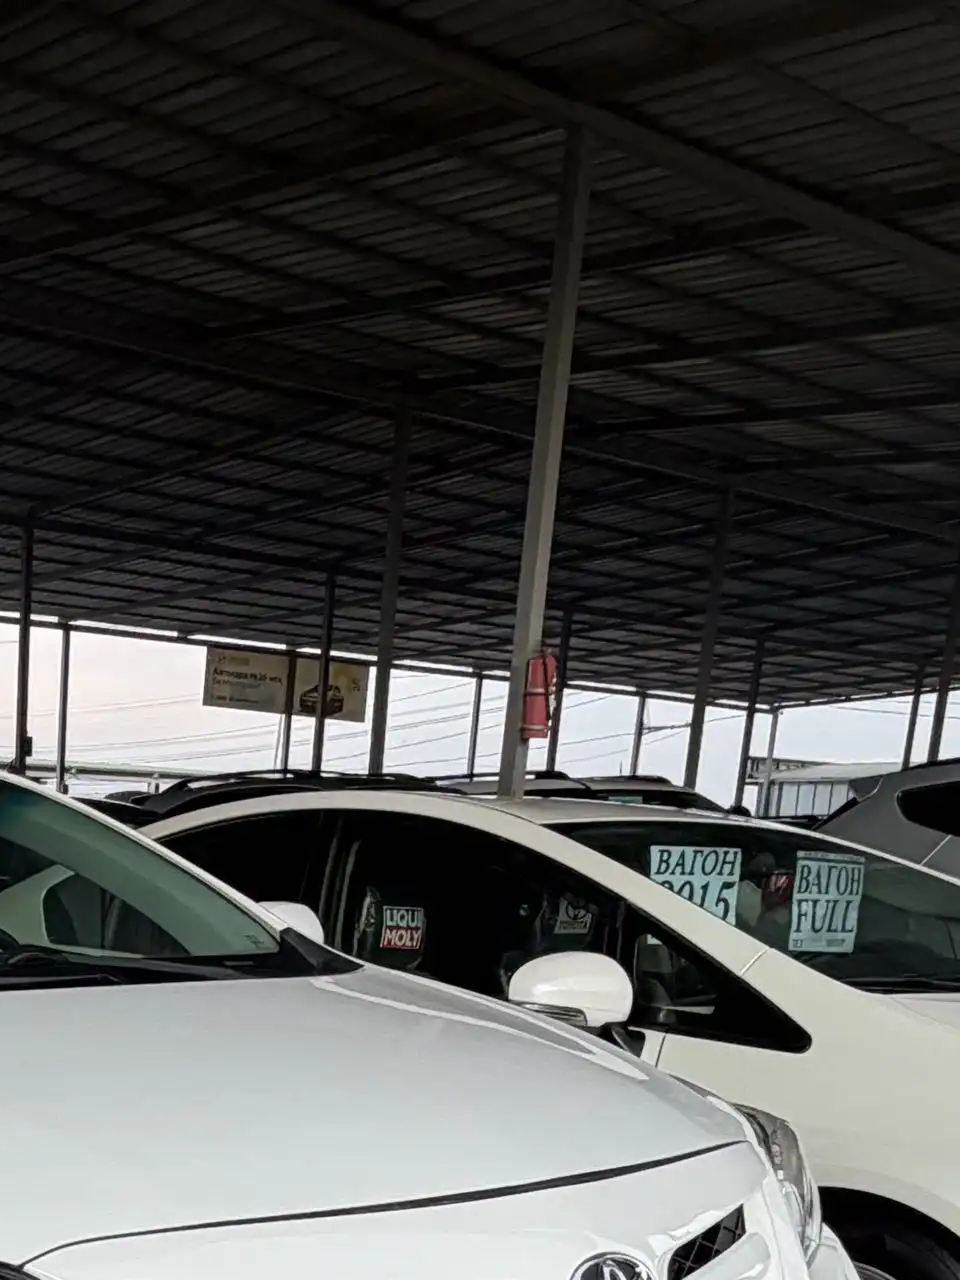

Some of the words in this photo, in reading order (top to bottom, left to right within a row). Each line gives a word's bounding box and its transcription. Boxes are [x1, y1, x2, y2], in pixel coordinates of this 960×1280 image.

[654, 849, 739, 876] ВАГОН
[797, 864, 862, 896] ВАГОН
[793, 899, 855, 933] FULL
[384, 928, 422, 947] MOLY
